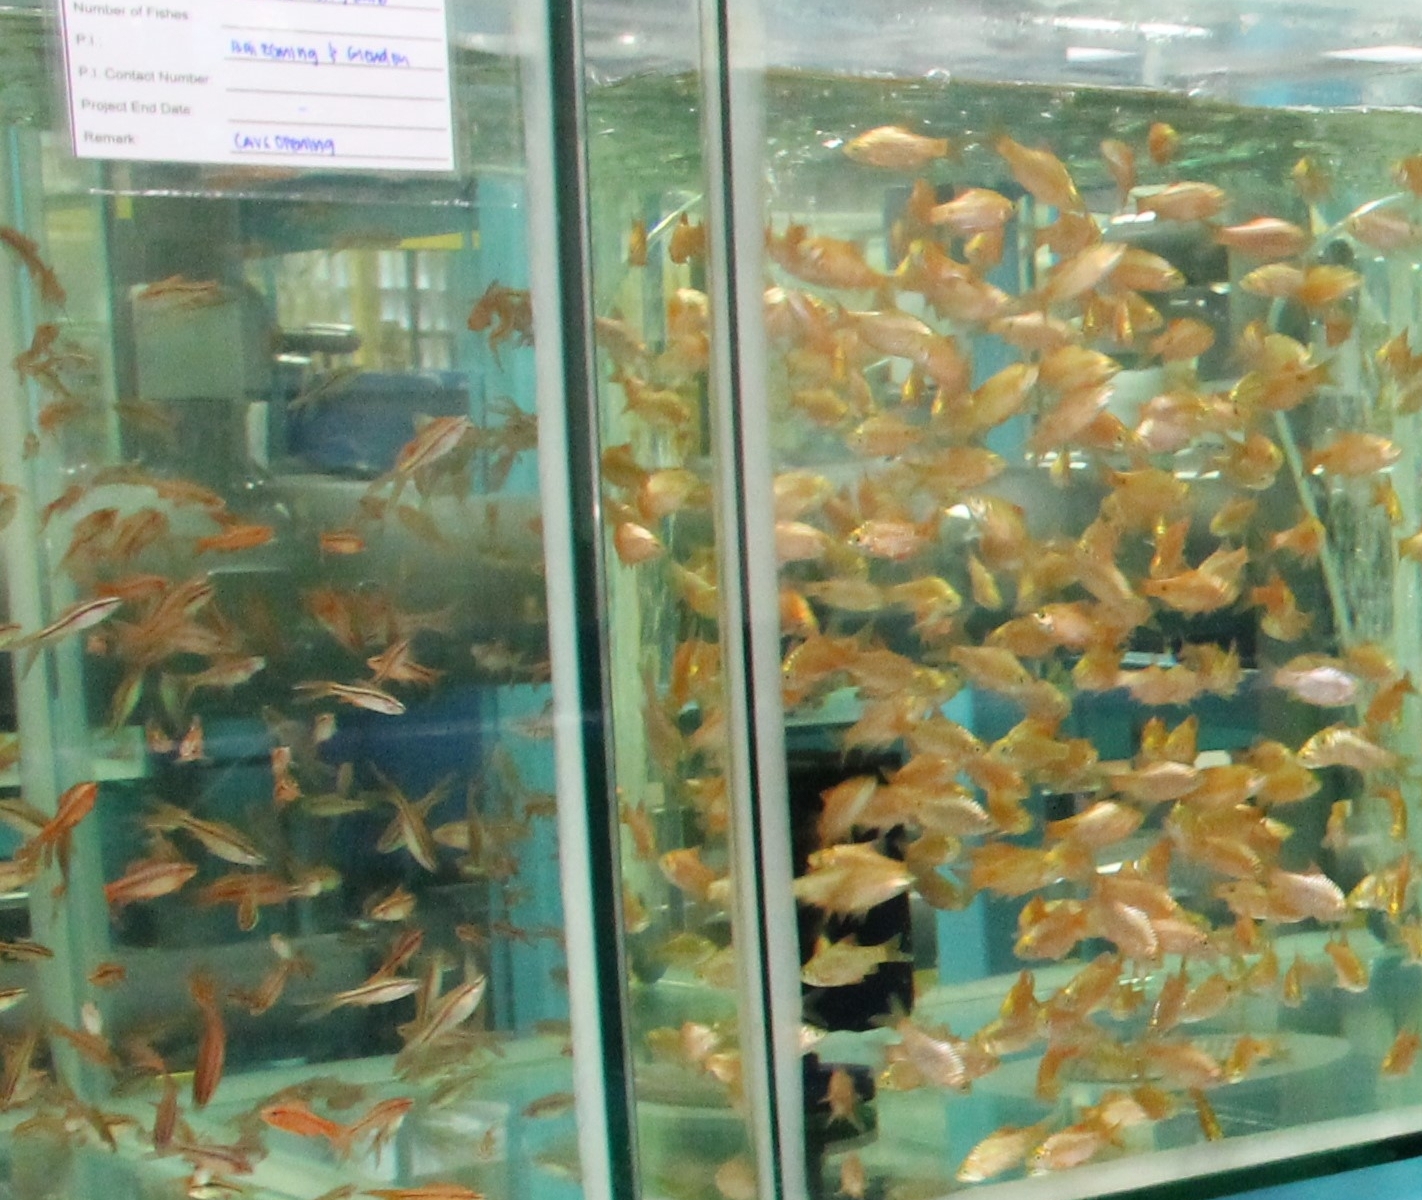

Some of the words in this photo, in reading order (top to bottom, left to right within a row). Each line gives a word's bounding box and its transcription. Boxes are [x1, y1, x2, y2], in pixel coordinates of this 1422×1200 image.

[73, 2, 125, 16] Number
[130, 6, 143, 17] of
[146, 7, 189, 20] Fishes
[104, 68, 154, 82] Contact
[159, 71, 209, 85] Number
[81, 99, 127, 115] Project
[131, 101, 157, 114] End
[160, 103, 191, 115] Date
[84, 131, 135, 145] Remark
